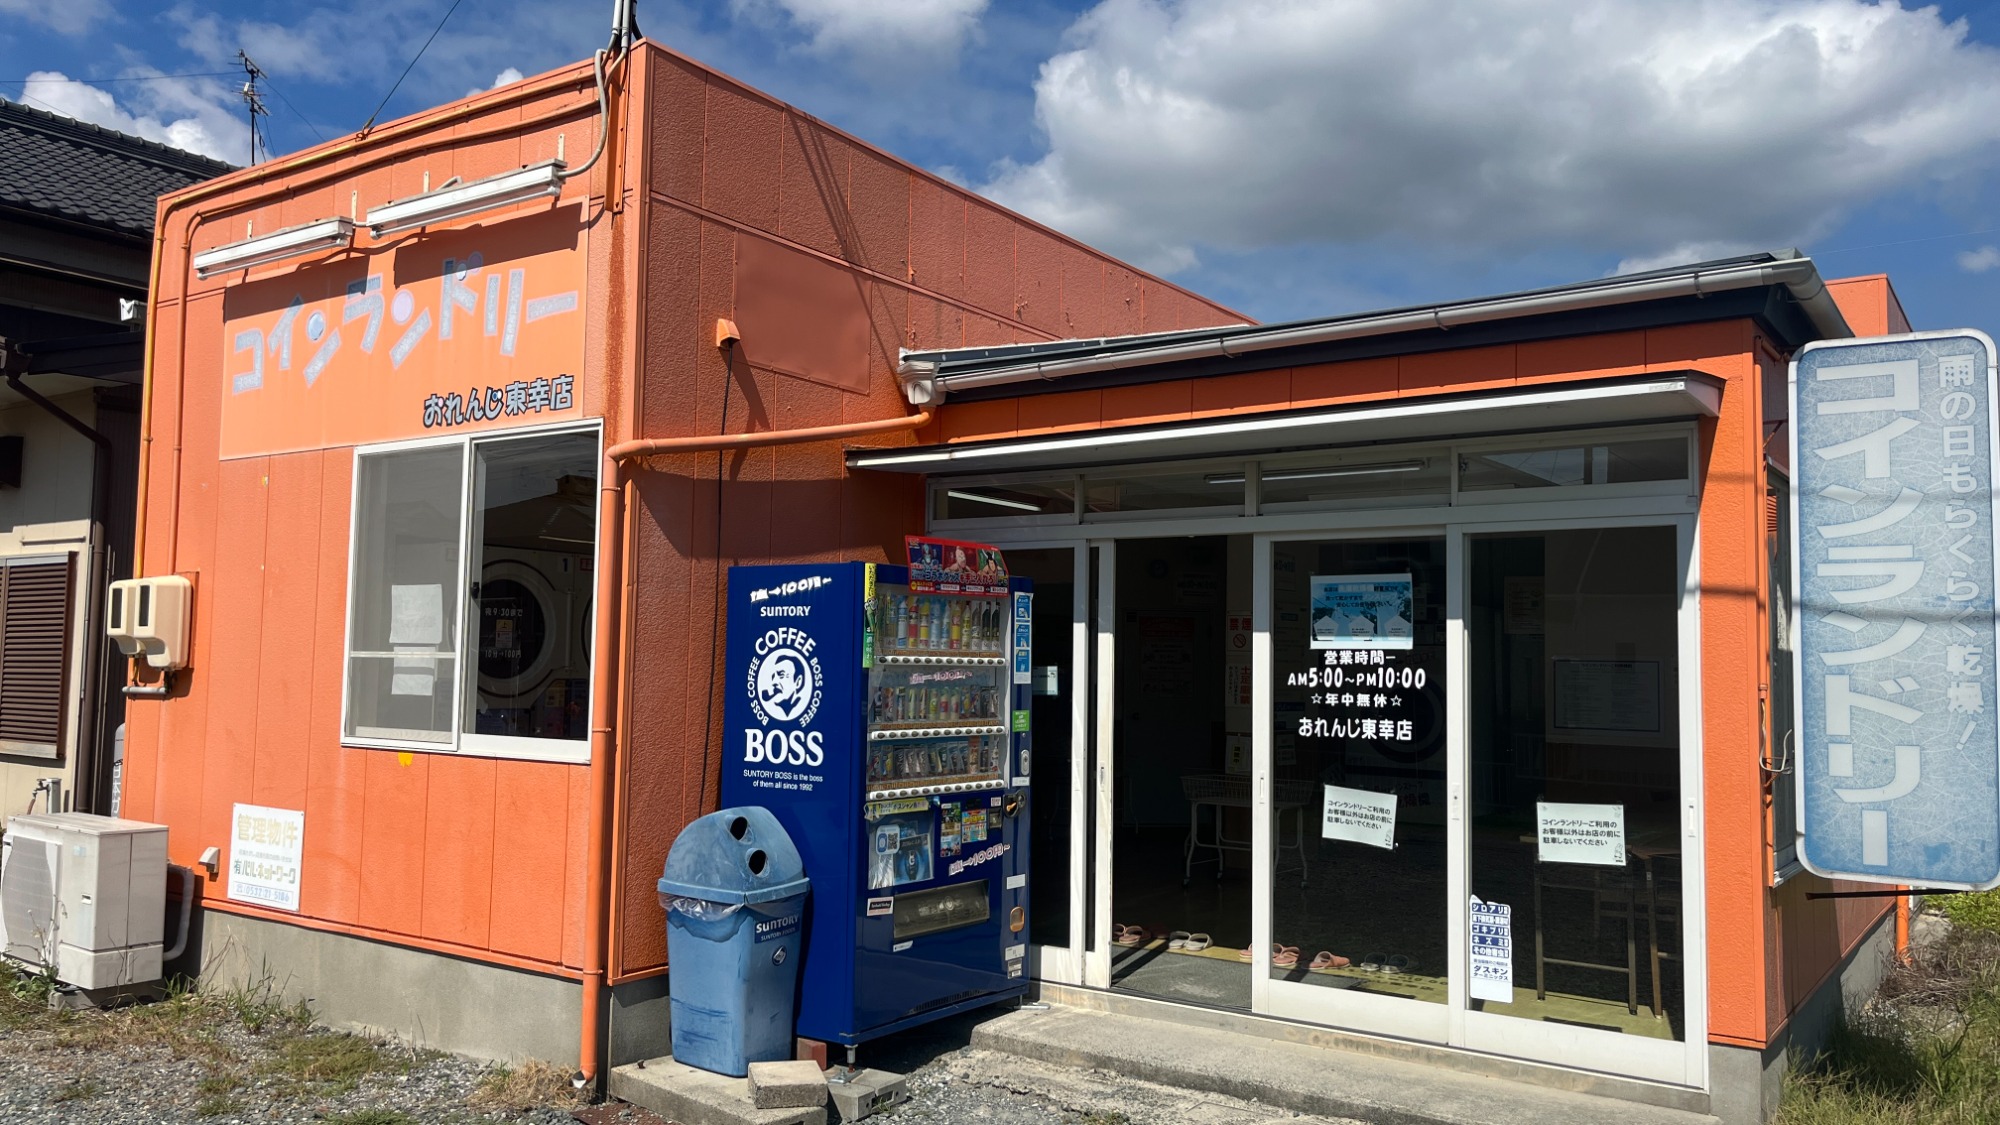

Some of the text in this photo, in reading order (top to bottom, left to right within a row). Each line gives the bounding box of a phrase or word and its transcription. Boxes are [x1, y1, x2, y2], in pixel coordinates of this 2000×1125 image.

[233, 251, 578, 394] コインランドリー
[424, 374, 575, 428] おれんじ東幸店
[760, 606, 811, 617] SUNTORY
[1813, 358, 1926, 867] コインランドリー
[1229, 617, 1251, 631] 禁煙
[755, 627, 817, 656] COFFEE
[747, 656, 769, 726] BOSS COFFEE
[800, 656, 823, 728] BOSS COFFEE
[1298, 717, 1413, 741] おれんじ東幸店
[743, 728, 824, 767] BOSS
[743, 769, 774, 778] SUNTORY
[774, 771, 792, 780] BOSS
[799, 773, 808, 781] the
[809, 774, 823, 782] boss
[759, 780, 774, 788] them
[783, 782, 798, 790] since
[799, 783, 813, 791] 1992
[1328, 800, 1391, 815] コインランドリーご利用の
[1327, 808, 1392, 824] お客様以外はお店の前に
[1327, 816, 1382, 830] 駐車しないでください
[1542, 819, 1617, 828] コインランドリーご利用の
[237, 813, 298, 849] 管理物件
[1542, 828, 1621, 838] お客様以外はお店の前に
[1543, 836, 1608, 846] 駐車しないでください
[1473, 904, 1503, 914] シロアリ
[756, 914, 799, 934] SUNTORY
[761, 931, 782, 941] SUNTORY
[1473, 964, 1508, 975] ダスキン
